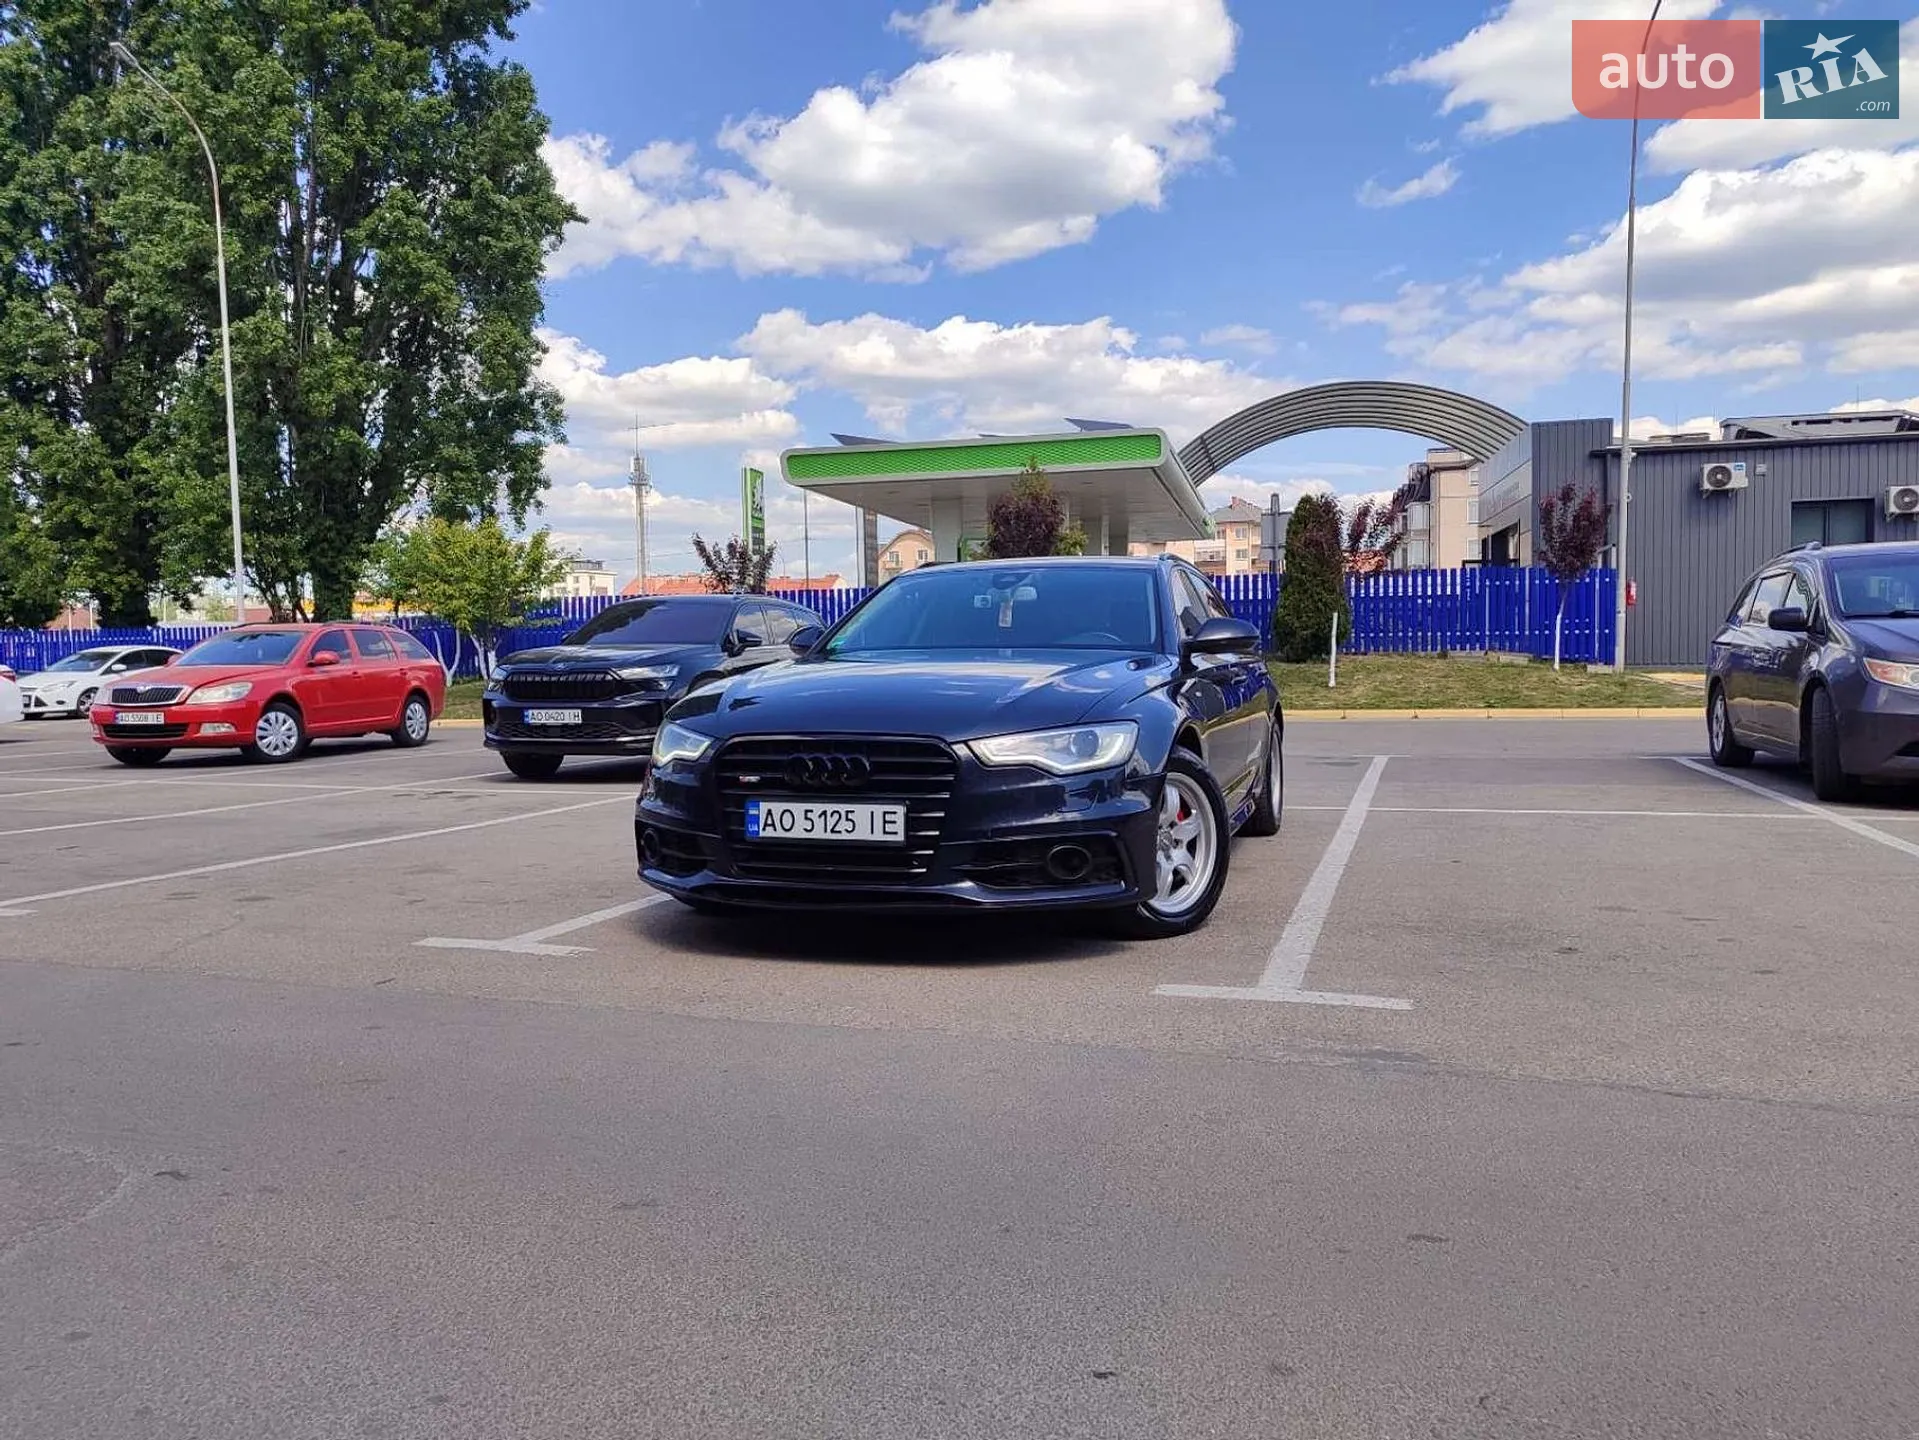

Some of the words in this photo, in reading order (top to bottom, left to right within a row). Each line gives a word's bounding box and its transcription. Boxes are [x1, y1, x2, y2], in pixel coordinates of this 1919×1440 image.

[531, 711, 543, 721] AO
[762, 808, 796, 832] AO
[803, 809, 856, 834] 5125
[870, 811, 898, 836] IE
